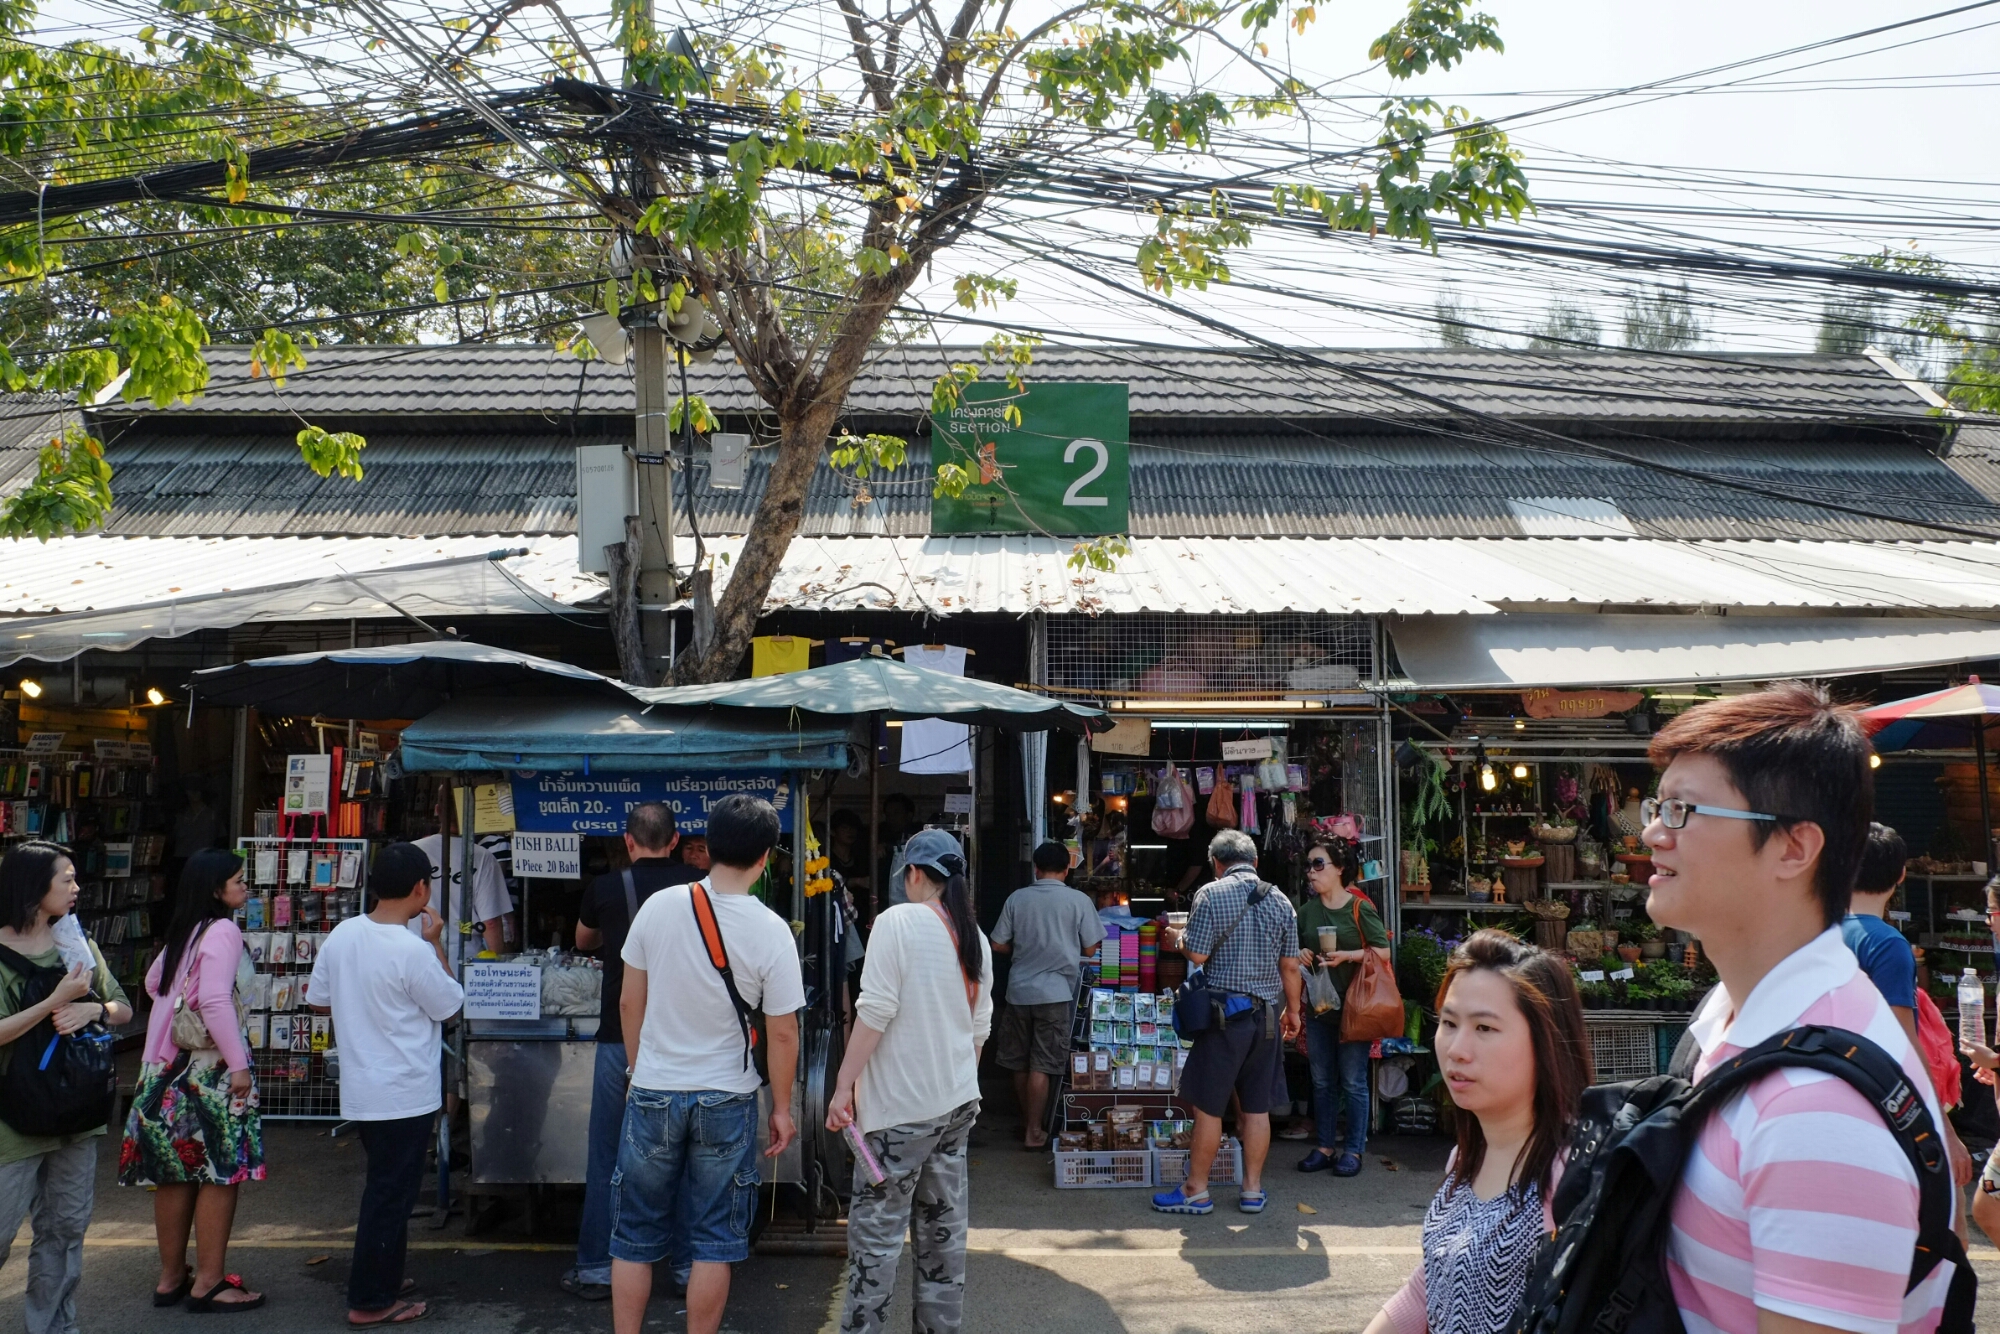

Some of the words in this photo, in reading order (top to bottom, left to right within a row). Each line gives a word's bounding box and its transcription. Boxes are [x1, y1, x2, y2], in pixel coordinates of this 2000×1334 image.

[950, 422, 1010, 433] SECTION
[1063, 438, 1109, 506] 2
[539, 775, 641, 793] น้ำจิ้มหวานเผ็ด
[666, 775, 776, 792] เปรี้ยวเผ็ดรสจัด
[539, 797, 579, 816] ชุดเล็ก
[572, 820, 617, 832] (ประตู
[515, 836, 542, 851] FISH
[545, 837, 578, 852] BALL
[515, 858, 520, 871] 4
[522, 859, 543, 872] Piece
[547, 860, 557, 873] 20
[559, 860, 579, 873] Baht
